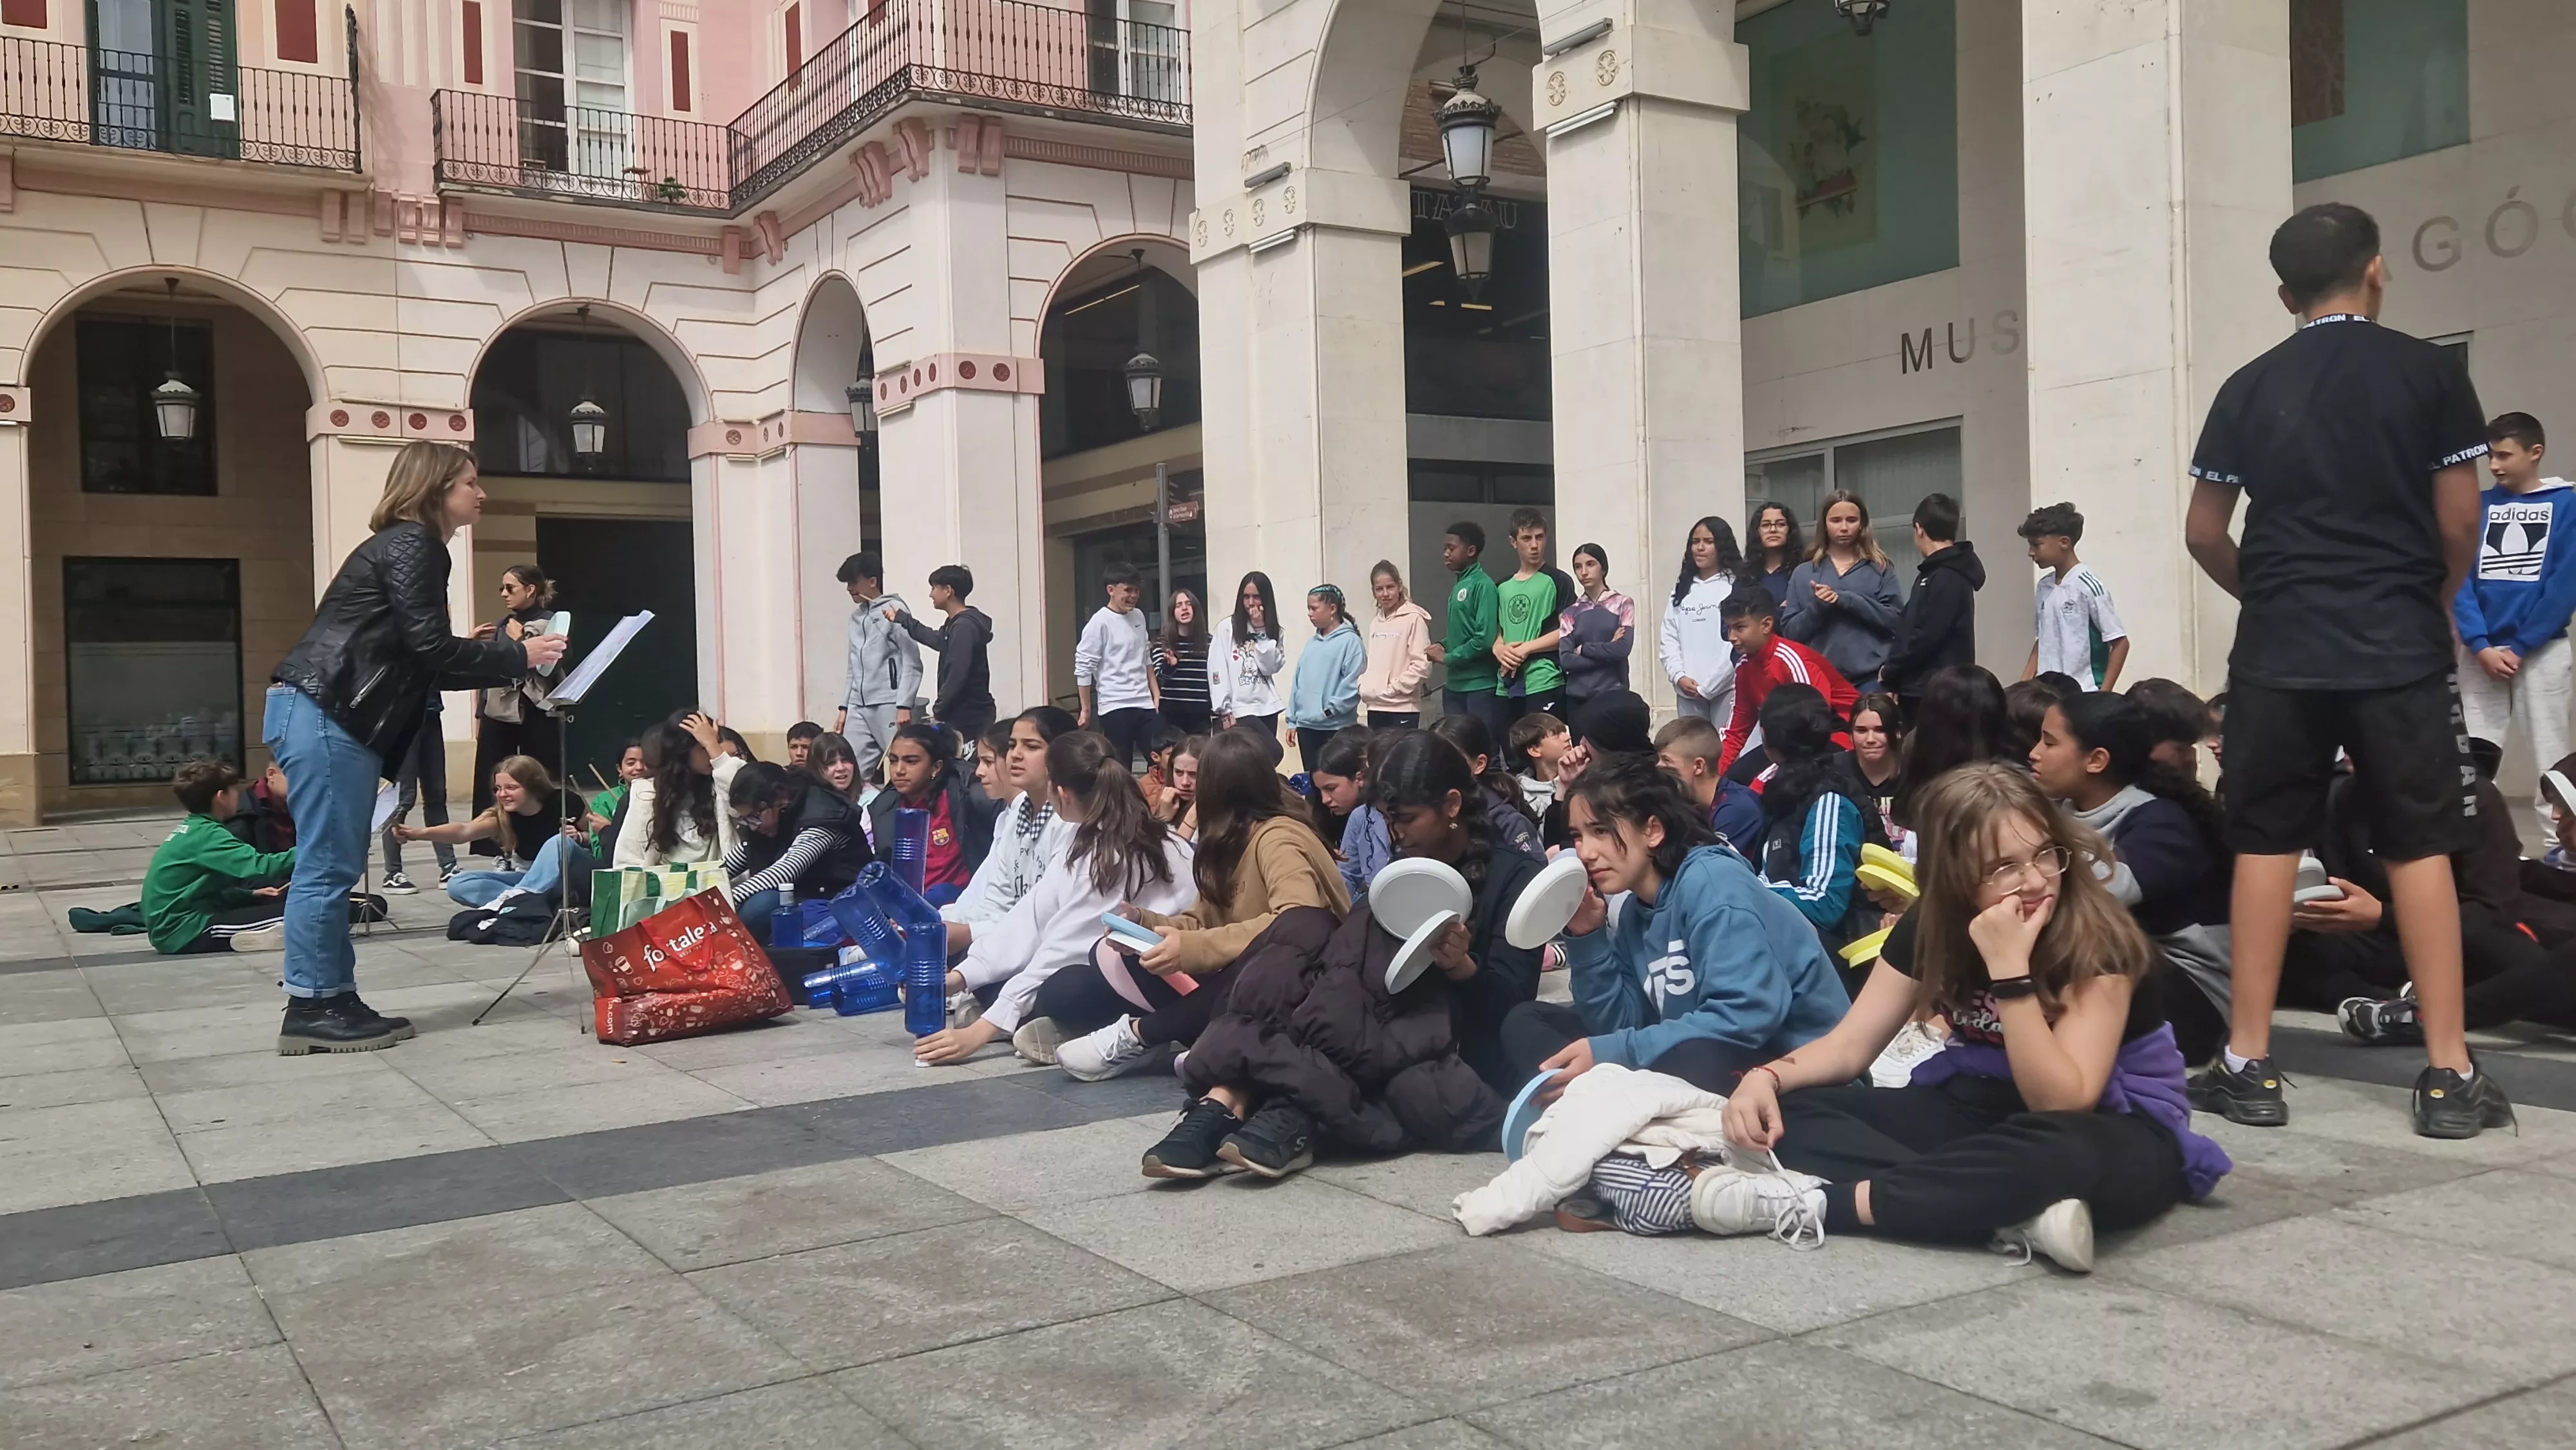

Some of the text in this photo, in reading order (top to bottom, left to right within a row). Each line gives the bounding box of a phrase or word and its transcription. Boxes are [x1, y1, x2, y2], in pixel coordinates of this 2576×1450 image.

[1901, 309, 2020, 375] MUS
[2442, 443, 2488, 466] PATRON
[2489, 507, 2550, 522] adidas
[643, 921, 718, 973] fotalea
